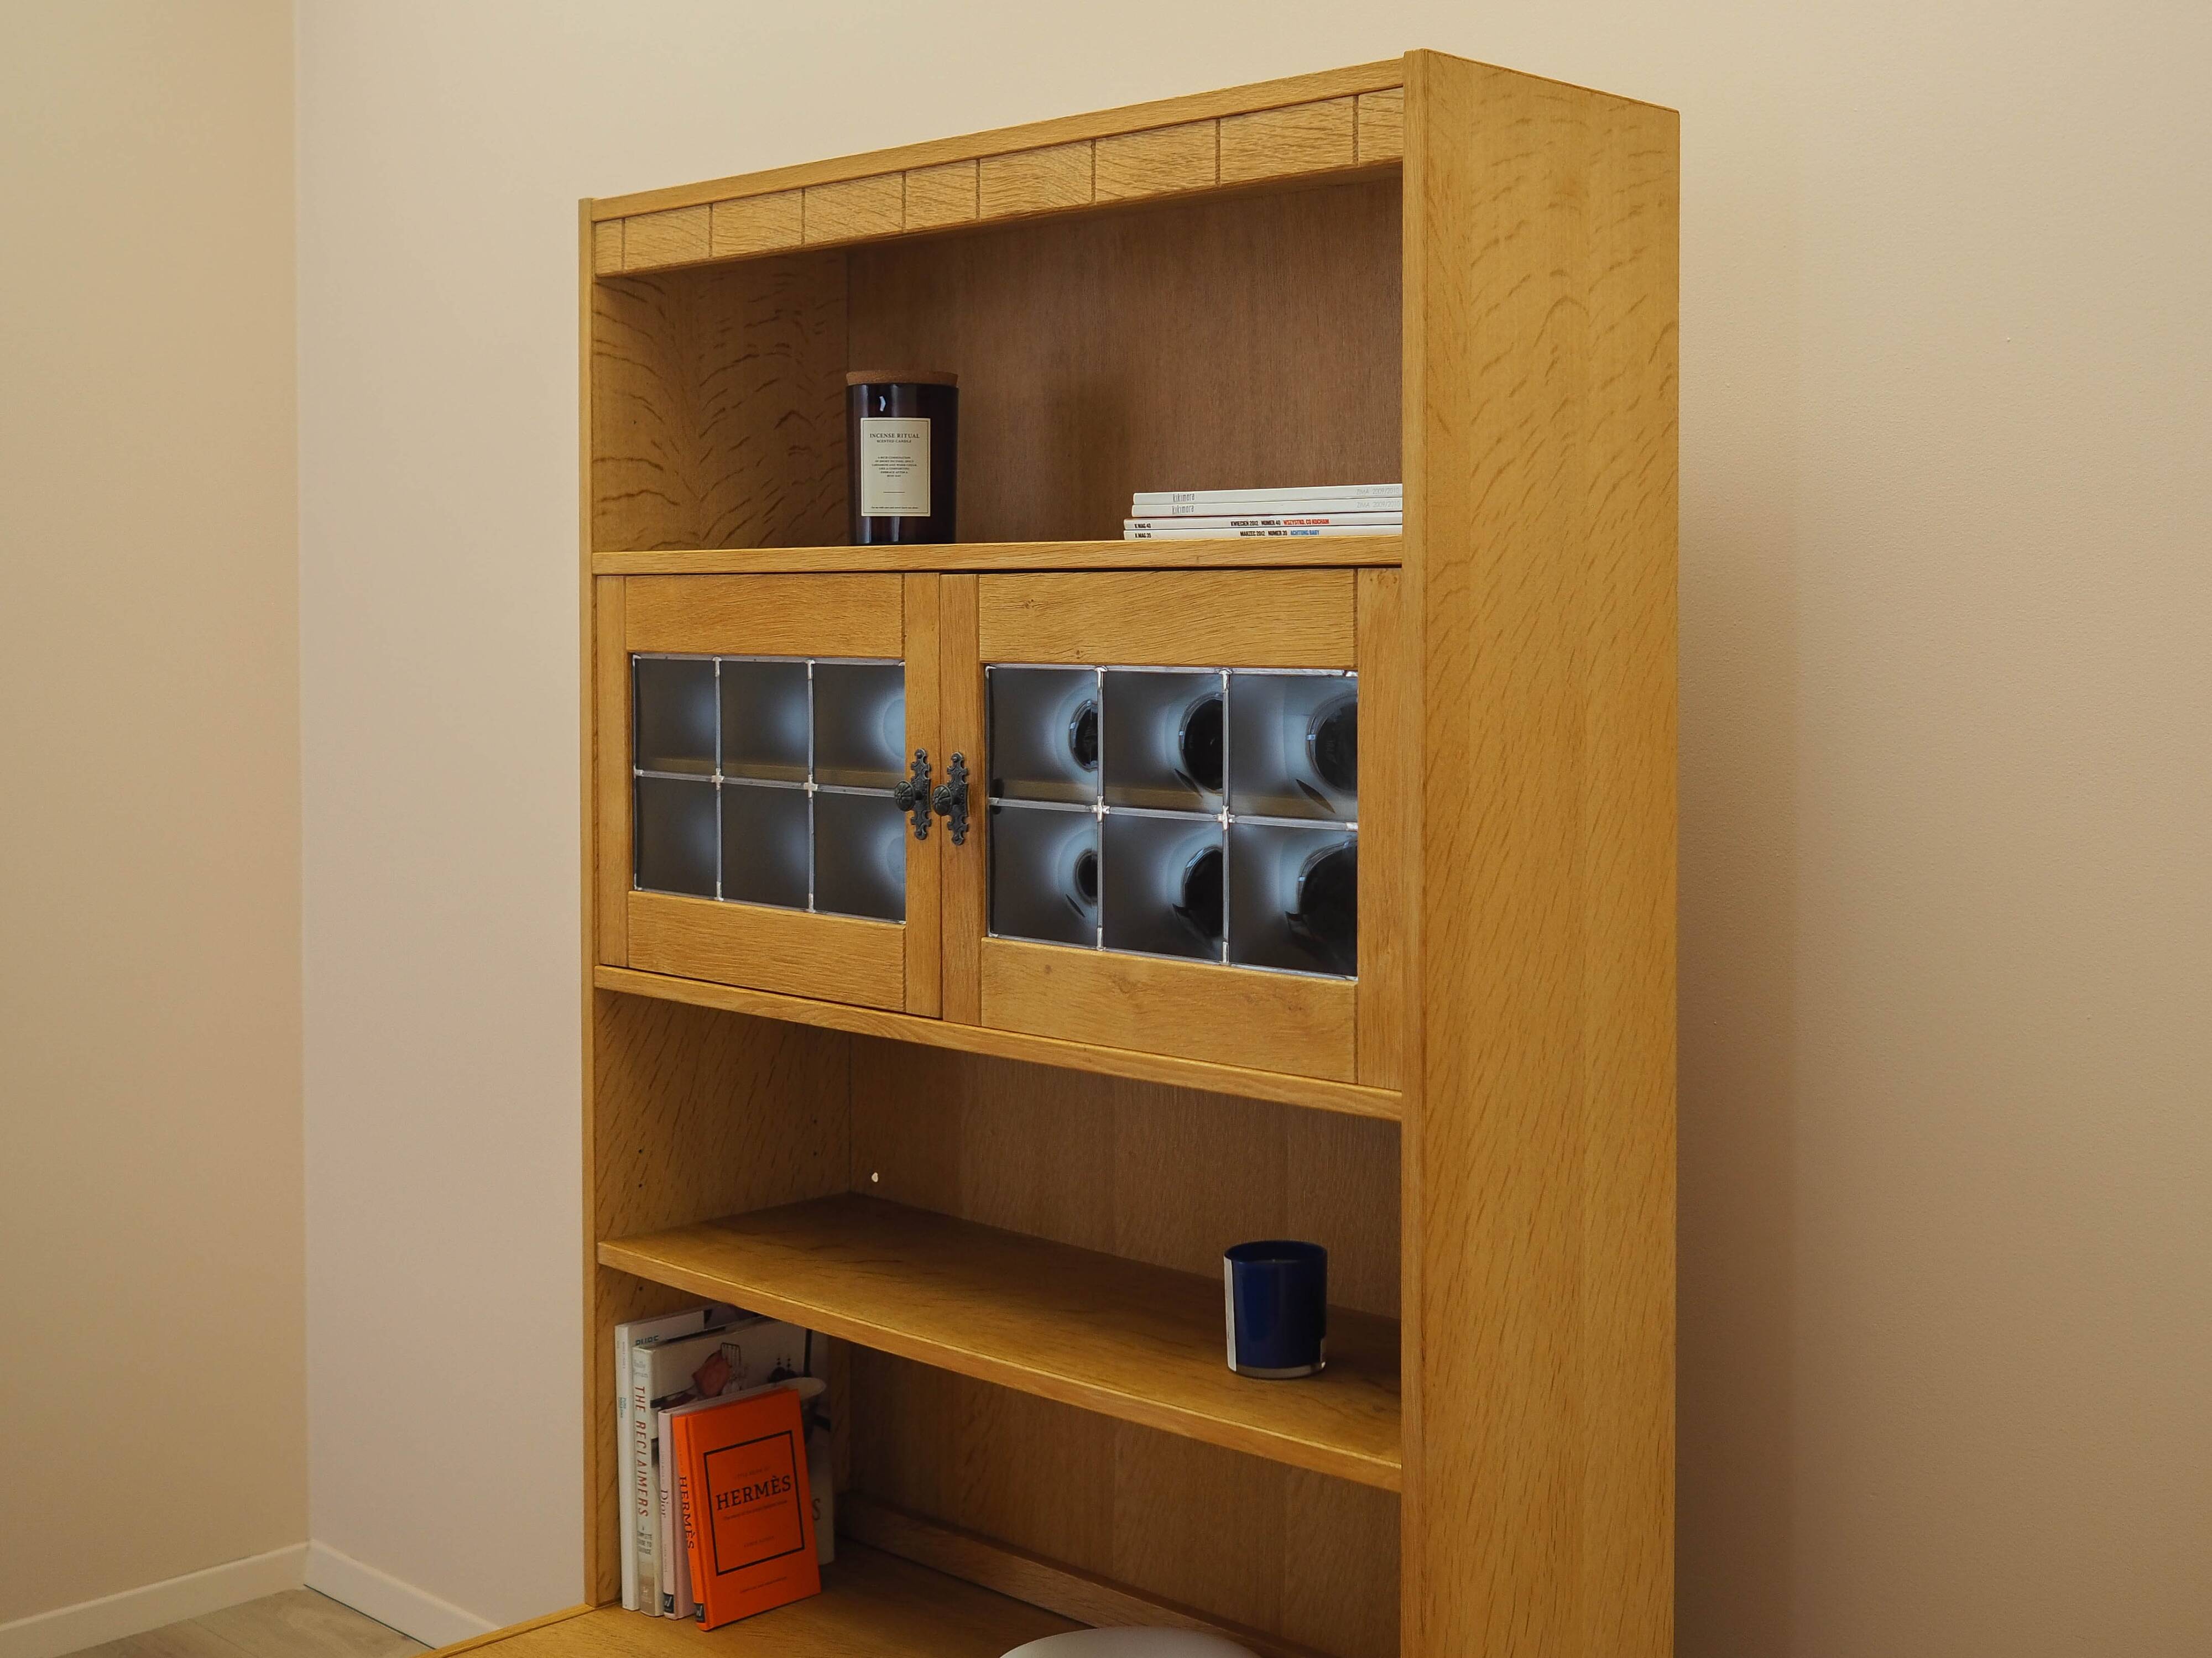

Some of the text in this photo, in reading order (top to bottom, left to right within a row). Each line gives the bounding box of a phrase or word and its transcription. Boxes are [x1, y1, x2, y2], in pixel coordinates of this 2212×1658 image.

[1172, 505, 1194, 515] kikimora
[1173, 493, 1195, 503] kikimora
[635, 1386, 646, 1413] THE
[636, 1420, 648, 1517] RECLAIMERS
[716, 1474, 792, 1510] HERMÈS
[680, 1476, 695, 1549] HERMÈS
